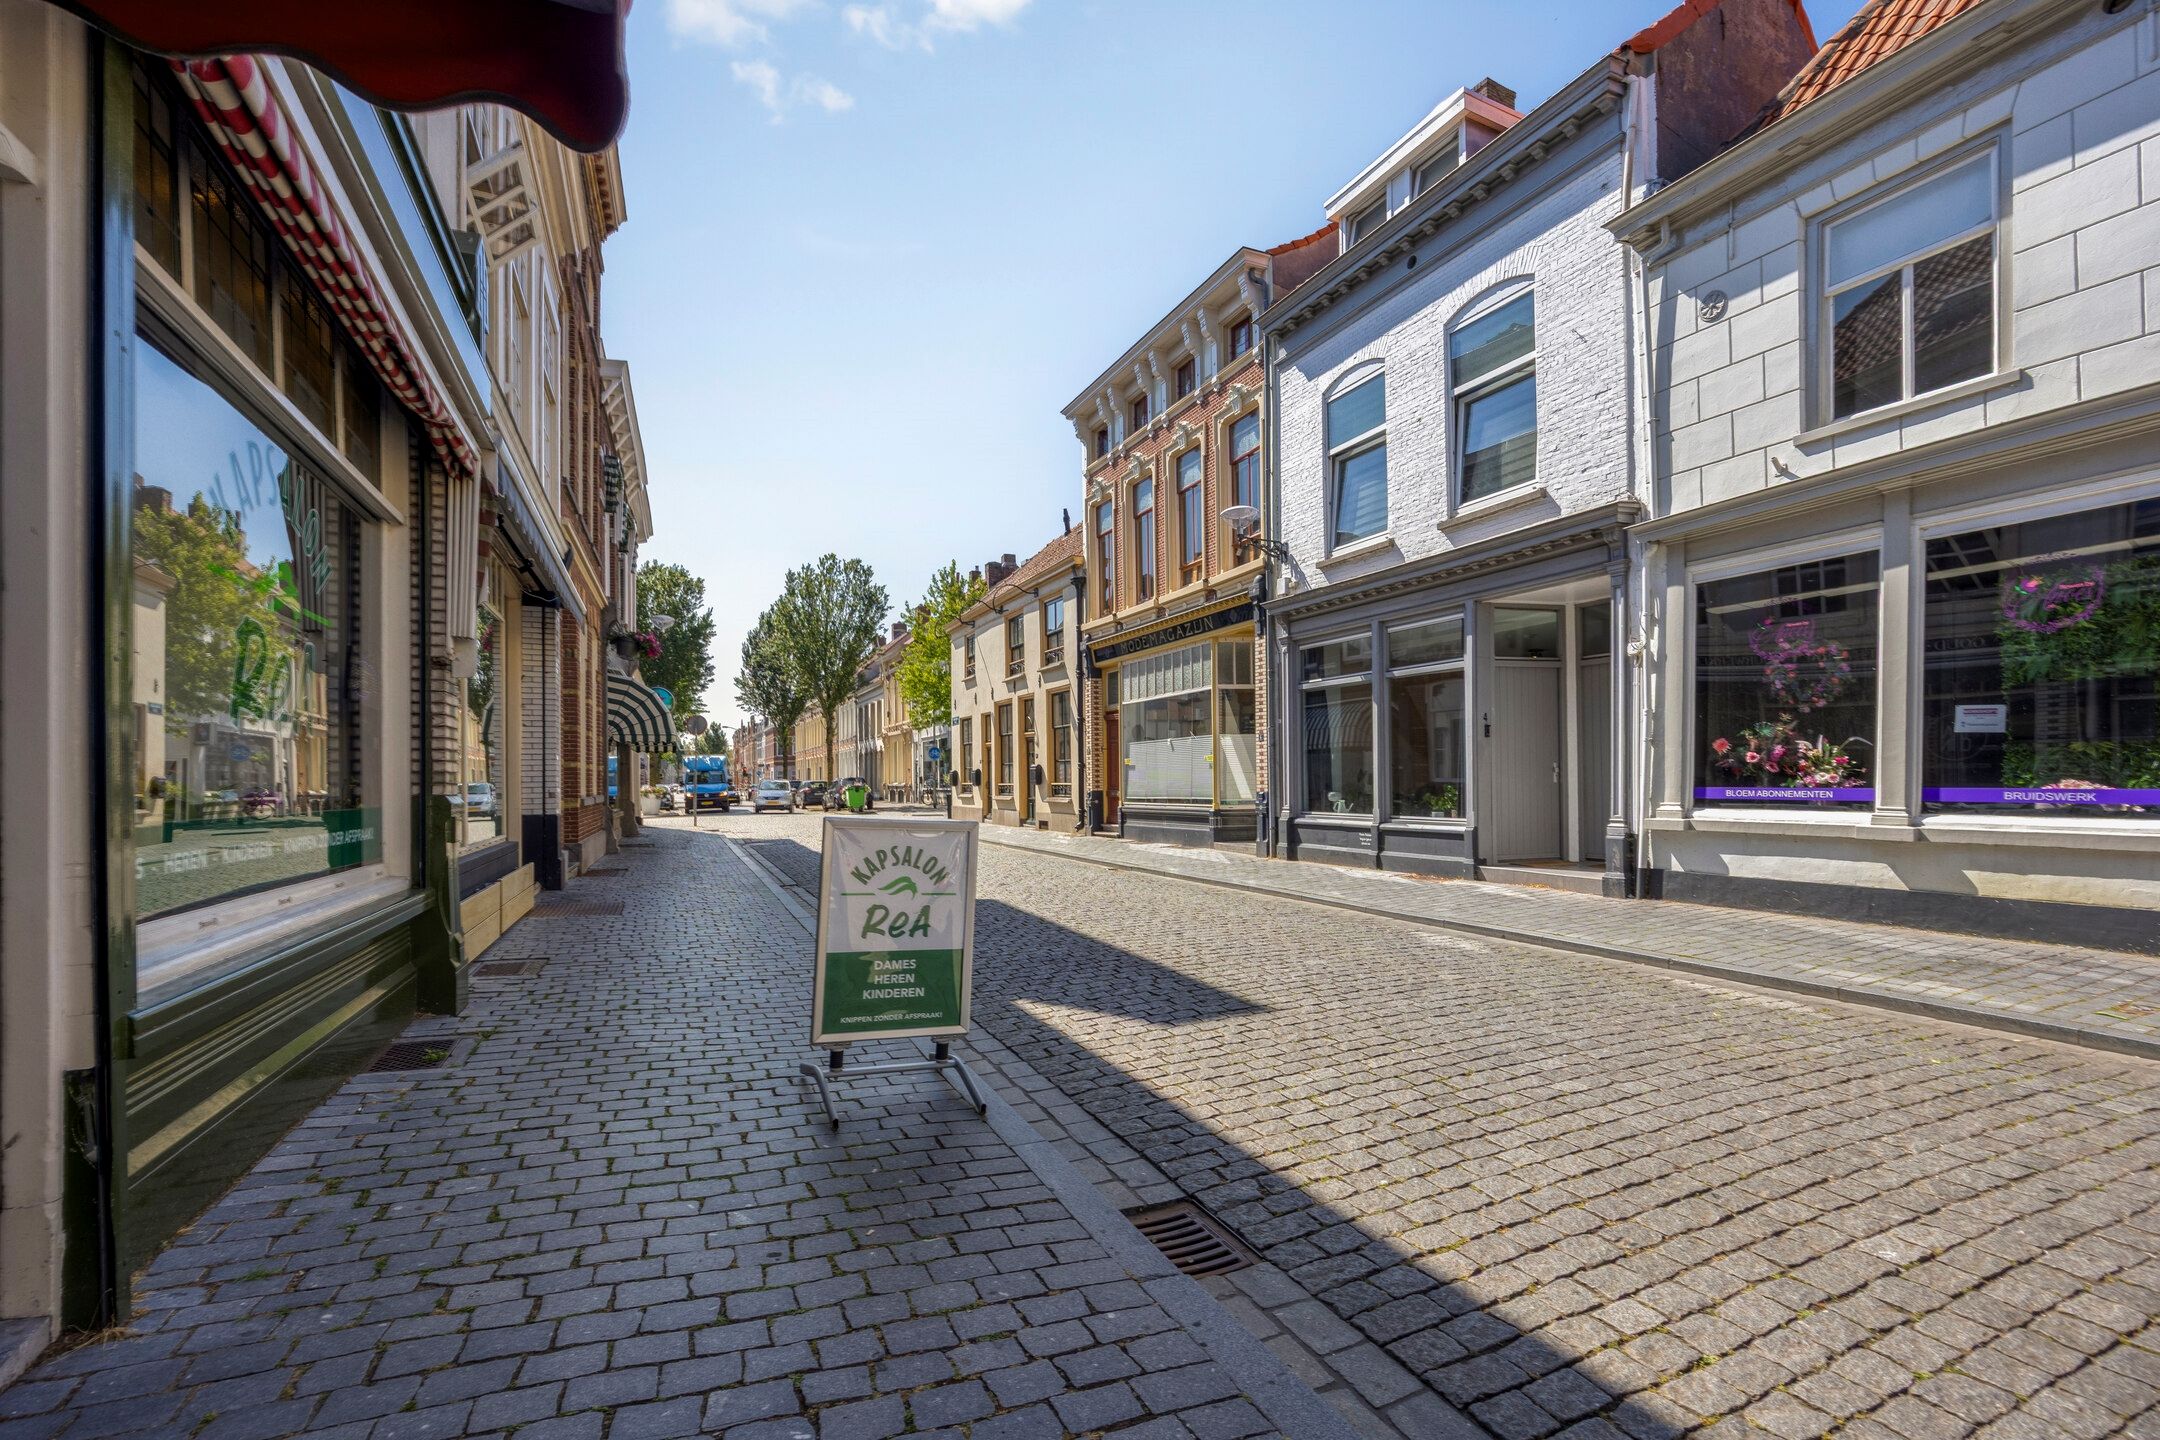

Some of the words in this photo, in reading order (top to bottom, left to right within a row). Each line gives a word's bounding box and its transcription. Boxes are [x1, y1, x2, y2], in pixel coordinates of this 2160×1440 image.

[207, 440, 333, 596] KAPSALON
[1725, 789, 1756, 798] BLOEM
[1757, 790, 1834, 799] ABONNEMENTEN
[2002, 791, 2097, 802] BRUIDSWERK
[850, 845, 950, 886] KAPSALON
[861, 904, 932, 940] ReA
[873, 959, 917, 970] DAMES
[873, 974, 916, 985] HEREN
[862, 987, 925, 1000] KINDEREN
[840, 1015, 873, 1023] KNIPPEN
[873, 1013, 903, 1022] ZONDER
[904, 1011, 943, 1020] AFSPRAAK!
